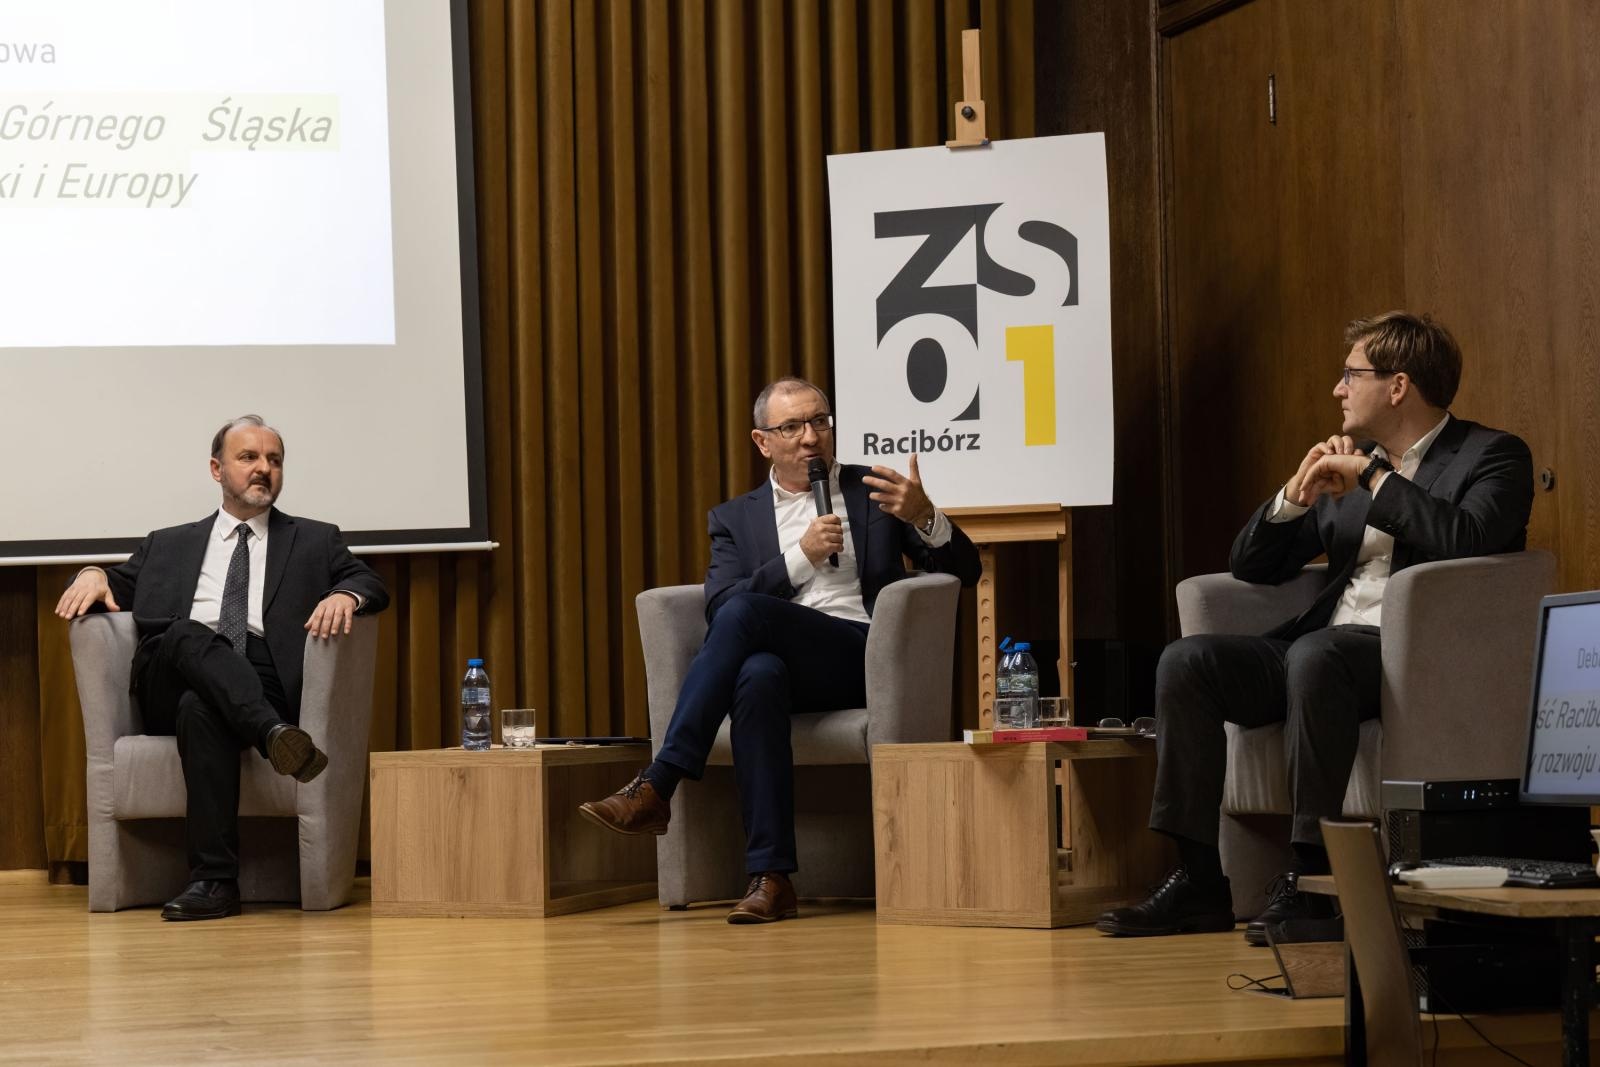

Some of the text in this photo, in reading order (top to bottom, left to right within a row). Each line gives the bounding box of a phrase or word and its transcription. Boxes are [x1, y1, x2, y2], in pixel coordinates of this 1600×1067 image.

[0, 43, 56, 64] owa
[1, 97, 332, 151] Górnego Śląska
[34, 164, 48, 198] i
[57, 163, 198, 208] Europy
[863, 429, 980, 455] Racibórz
[1577, 646, 1600, 669] Deb
[1538, 745, 1597, 780] rozwoju
